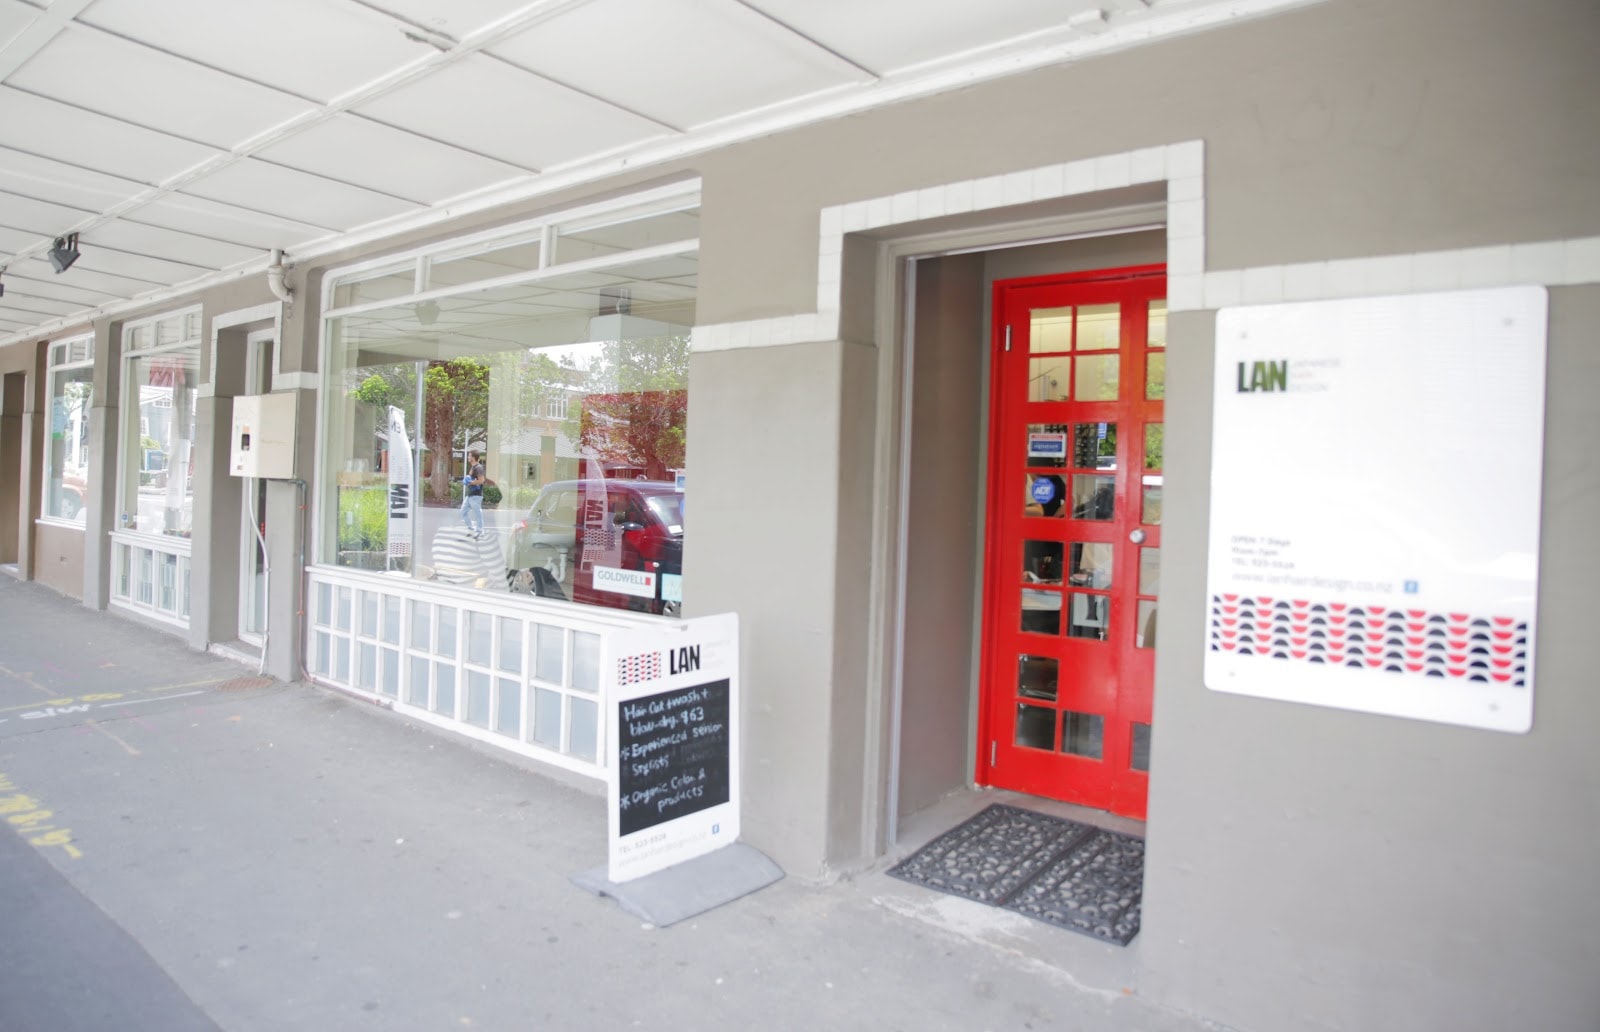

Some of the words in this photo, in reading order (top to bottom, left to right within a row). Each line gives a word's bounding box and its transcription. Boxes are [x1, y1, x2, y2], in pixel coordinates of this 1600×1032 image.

[1236, 359, 1289, 393] LAN
[1034, 486, 1051, 496] ADT
[597, 570, 645, 585] GOLDWELL
[670, 643, 701, 676] LAN
[624, 704, 647, 721] Hair
[632, 731, 688, 758] Experienced
[657, 785, 704, 813] products
